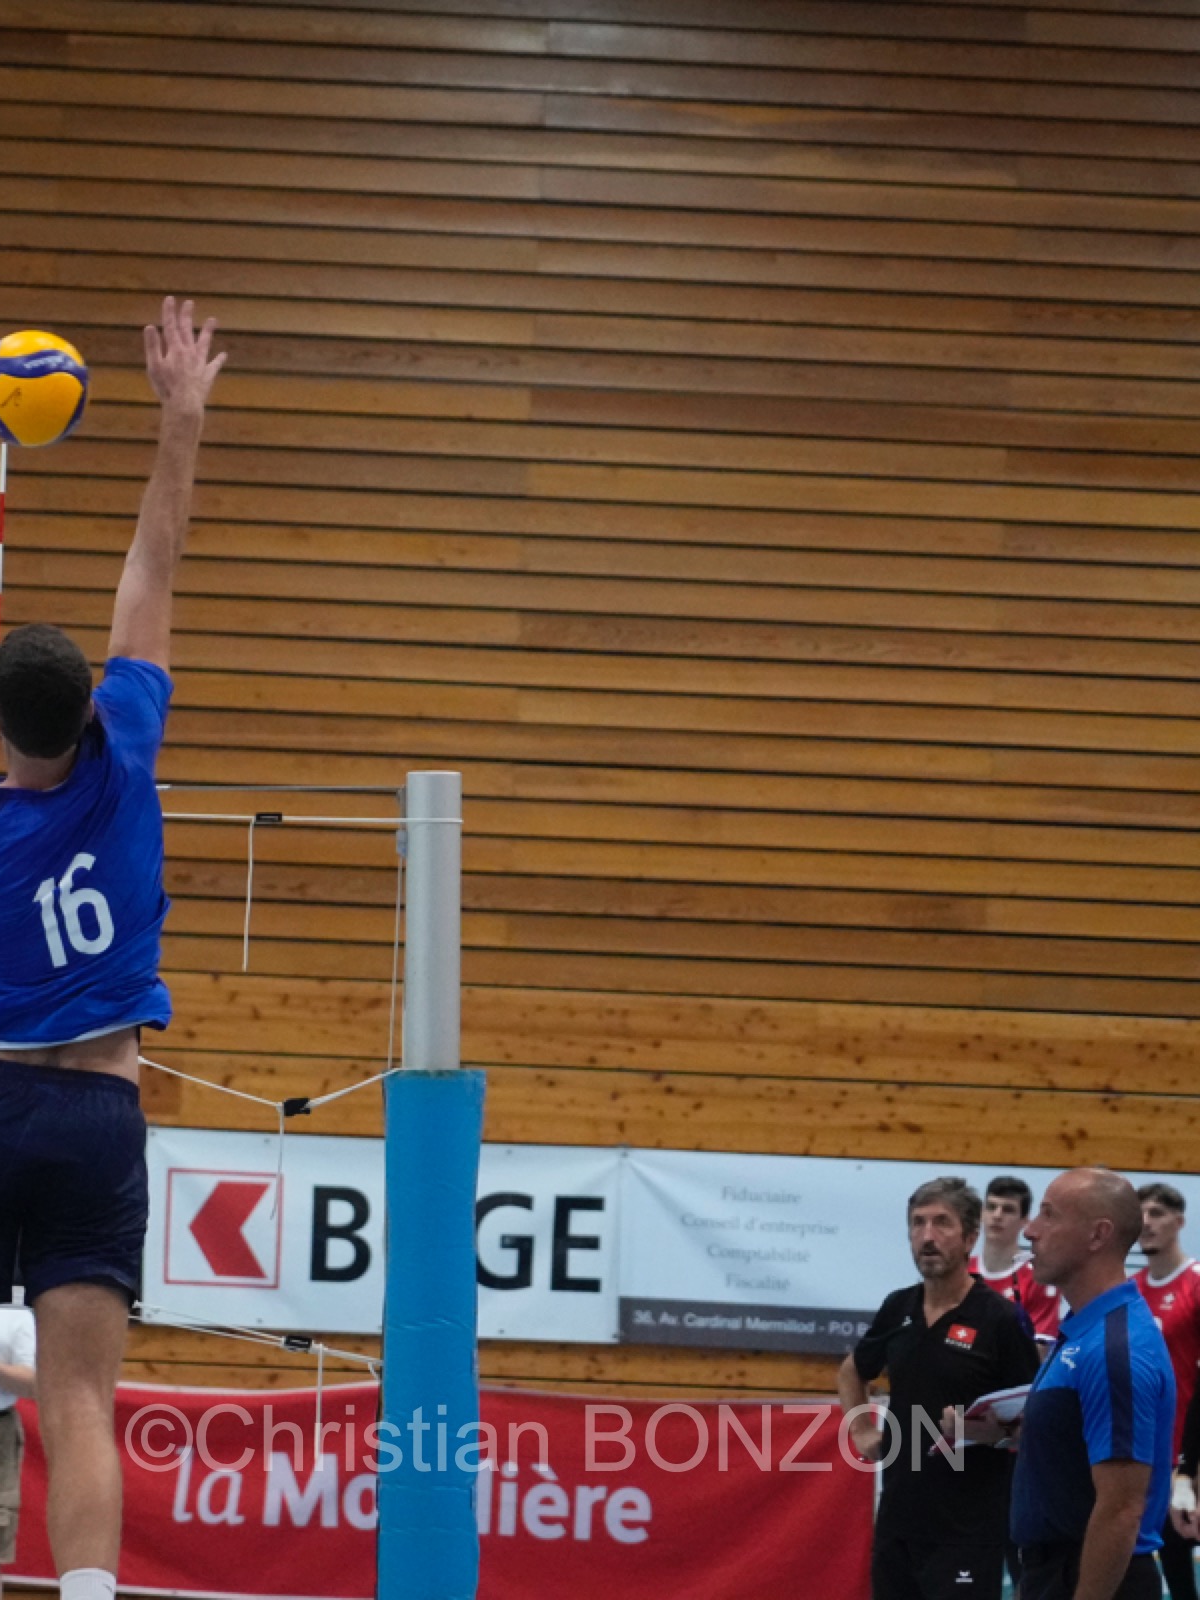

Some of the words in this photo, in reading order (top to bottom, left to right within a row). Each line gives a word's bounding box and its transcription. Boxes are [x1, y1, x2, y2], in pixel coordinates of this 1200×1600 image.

[32, 852, 115, 968] 16
[310, 1184, 605, 1293] BGE
[172, 1445, 246, 1526] la
[262, 1447, 654, 1545] Molière
